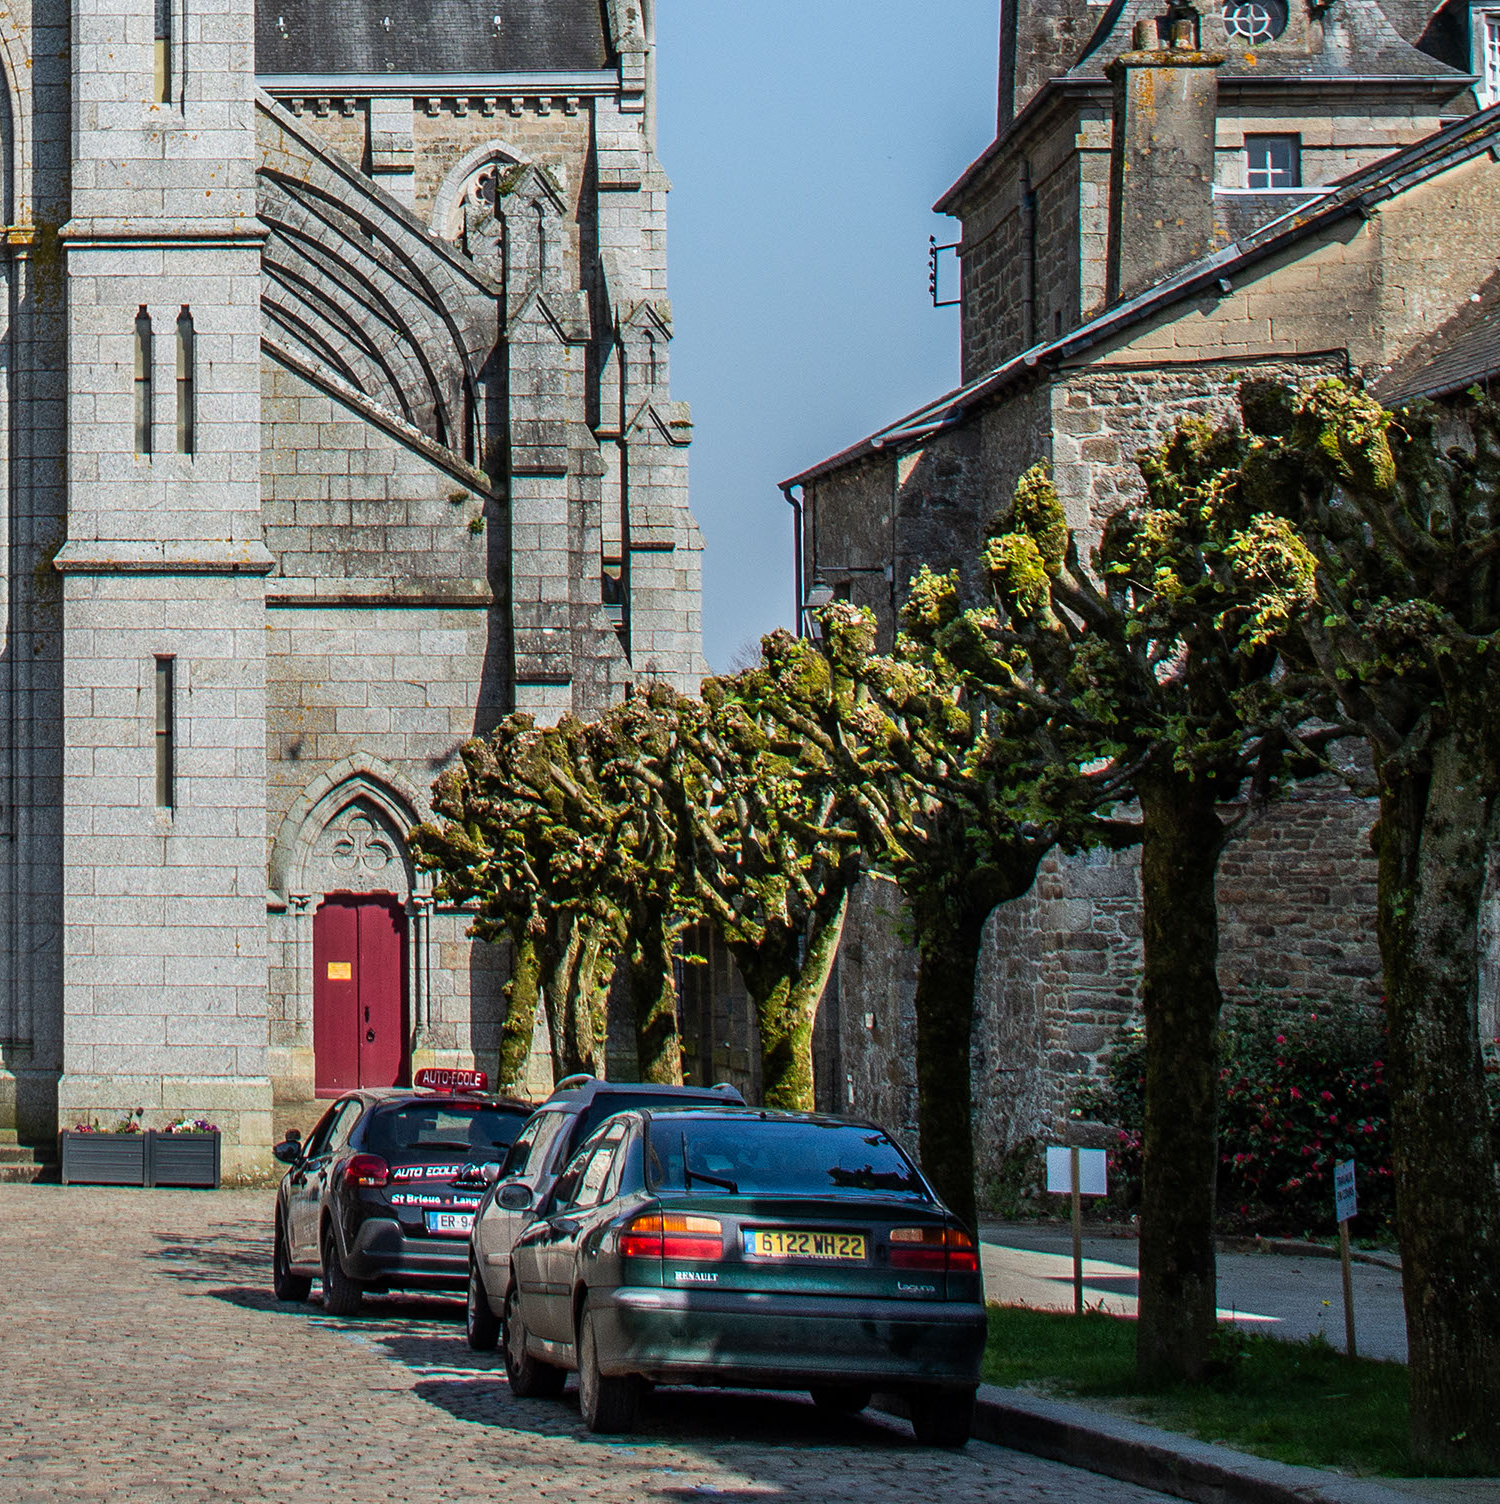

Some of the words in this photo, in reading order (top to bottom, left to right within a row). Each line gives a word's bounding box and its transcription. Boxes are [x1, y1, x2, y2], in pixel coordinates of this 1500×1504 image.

[422, 1070, 481, 1087] AUTO-ECOLE
[394, 1166, 423, 1179] AUTO
[426, 1165, 459, 1178] ECOLE
[391, 1193, 405, 1204] St
[675, 1271, 719, 1282] RENAULT
